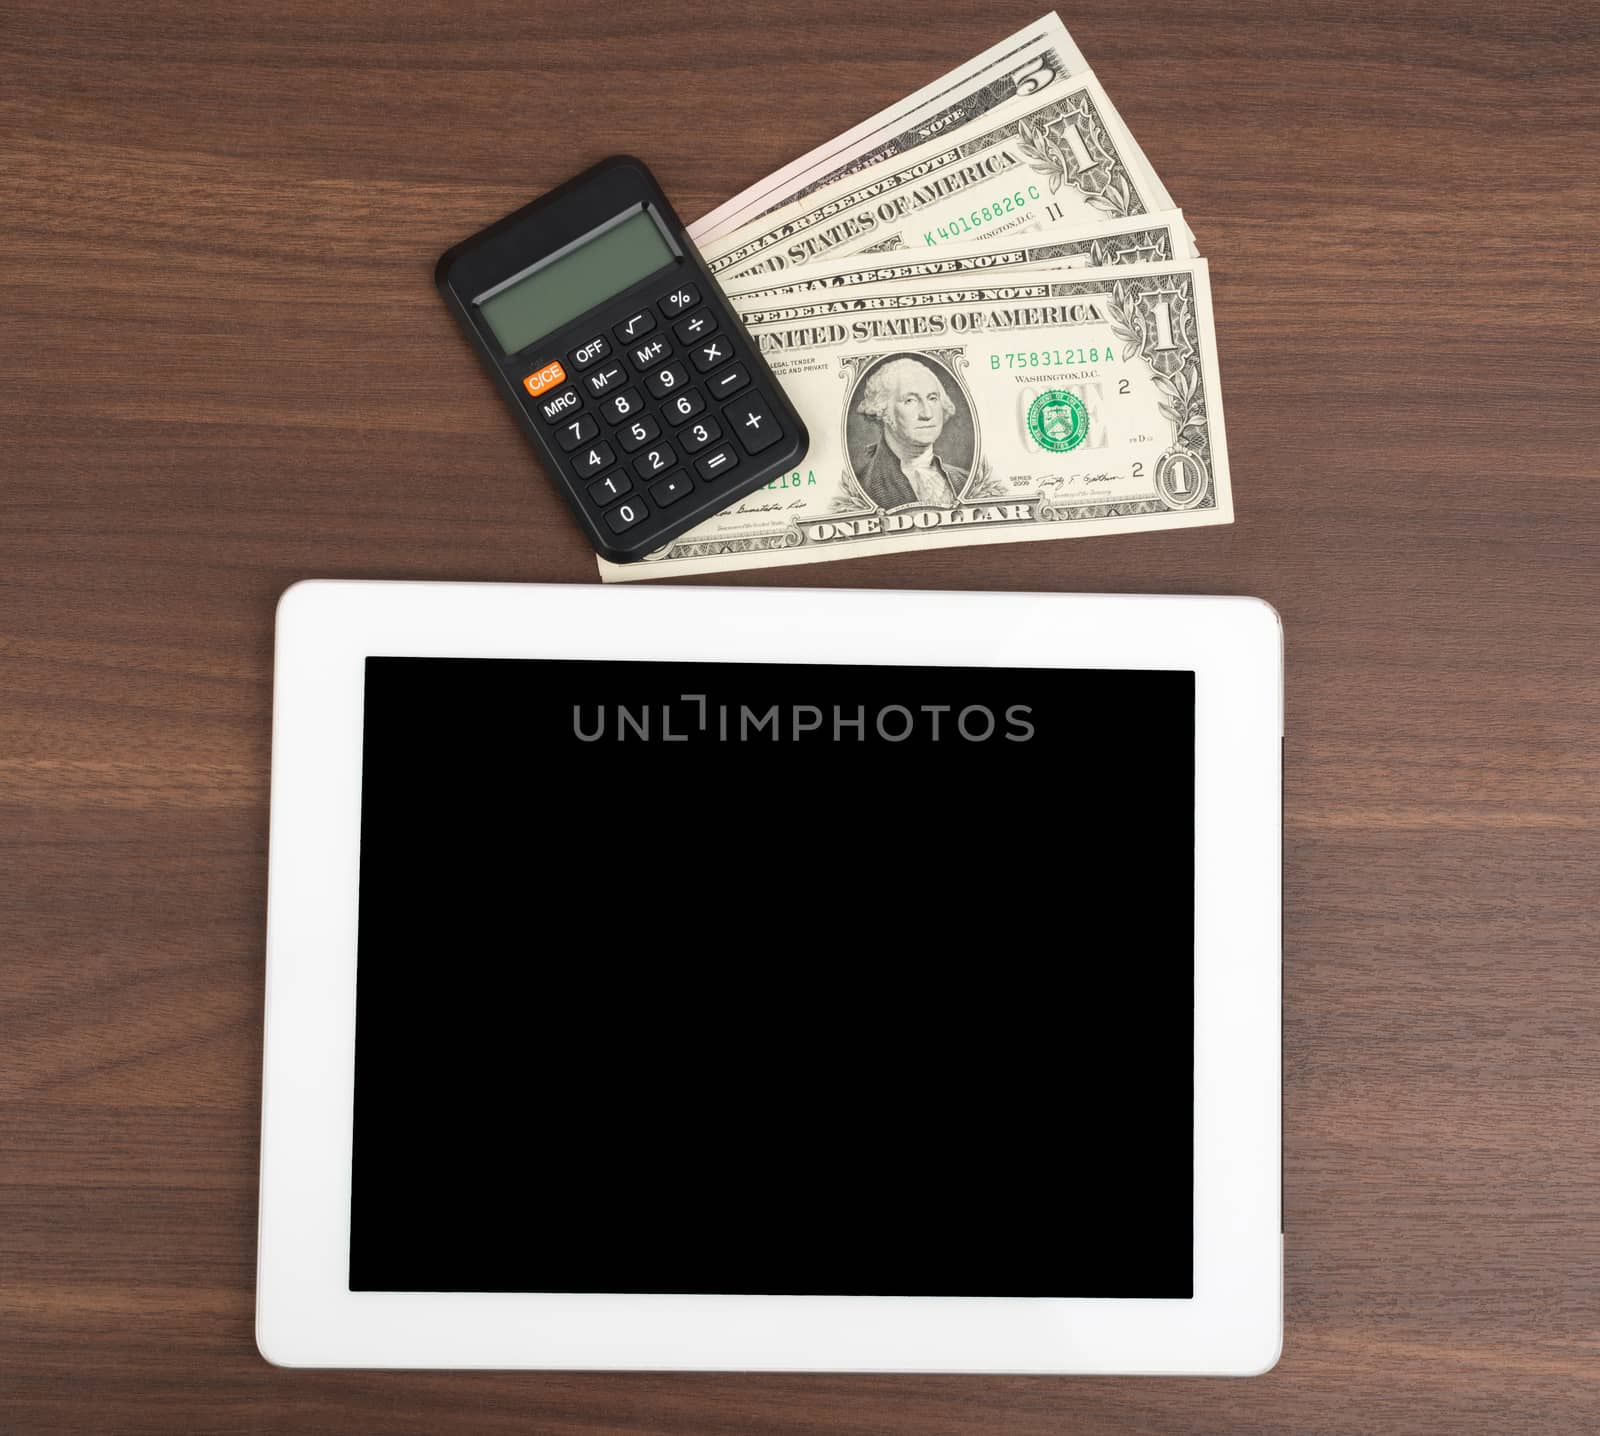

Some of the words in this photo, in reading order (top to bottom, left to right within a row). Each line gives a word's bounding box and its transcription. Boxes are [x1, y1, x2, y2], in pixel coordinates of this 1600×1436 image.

[1014, 54, 1057, 96] 5
[917, 107, 966, 139] NOTE
[1061, 123, 1099, 174] 1
[790, 178, 898, 229] RESERVE
[899, 150, 960, 186] NOTE
[788, 211, 878, 267] STATES
[877, 196, 912, 223] OF
[911, 150, 1020, 209] AMERICA
[841, 260, 958, 286] RESERVE
[959, 251, 1024, 270] NOTE
[746, 300, 862, 324] FEDERAL
[862, 289, 982, 310] RESERVE
[982, 286, 1046, 300] NOTE
[753, 325, 847, 350] UNITED
[852, 314, 946, 339] STATES
[950, 312, 985, 332] OF
[985, 303, 1103, 329] AMERICA
[1151, 302, 1178, 351] 1
[576, 340, 603, 363] OFF
[636, 341, 663, 363] M+
[790, 358, 816, 366] TENDER
[528, 364, 563, 392] C/CE
[803, 363, 829, 372] PRIVATE
[660, 371, 675, 388] 9
[1118, 379, 1131, 394] 2
[543, 395, 578, 417] MRC
[615, 397, 630, 414] 8
[676, 398, 692, 414] 6
[568, 422, 582, 440] 7
[631, 423, 647, 441] 5
[693, 426, 708, 442] 3
[588, 450, 602, 466] 4
[649, 452, 665, 469] 2
[1132, 463, 1144, 478] 2
[1172, 461, 1192, 494] 1
[604, 478, 617, 493] 1
[620, 505, 635, 522] 0
[808, 518, 884, 541] ONE
[885, 504, 1034, 533] DOLLAR
